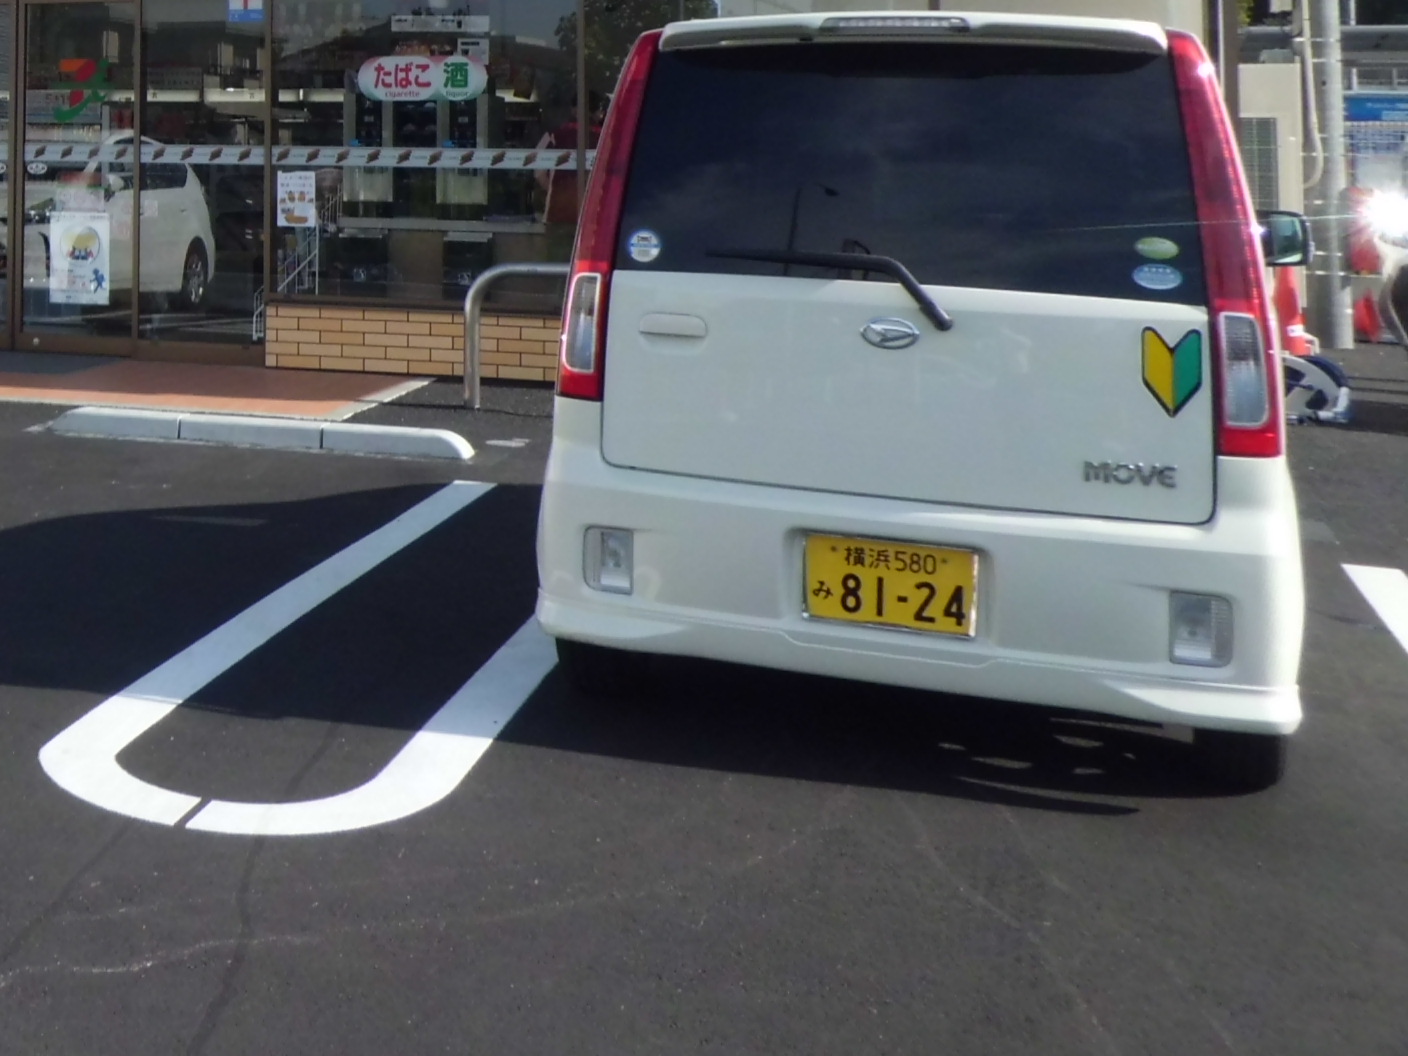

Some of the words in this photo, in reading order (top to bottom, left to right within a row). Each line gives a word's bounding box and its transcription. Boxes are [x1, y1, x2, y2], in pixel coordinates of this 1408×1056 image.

[374, 62, 432, 89] たばこ
[443, 62, 469, 88] 酒
[1083, 460, 1178, 489] MOVE
[812, 580, 833, 600] み
[841, 573, 966, 626] 81-24
